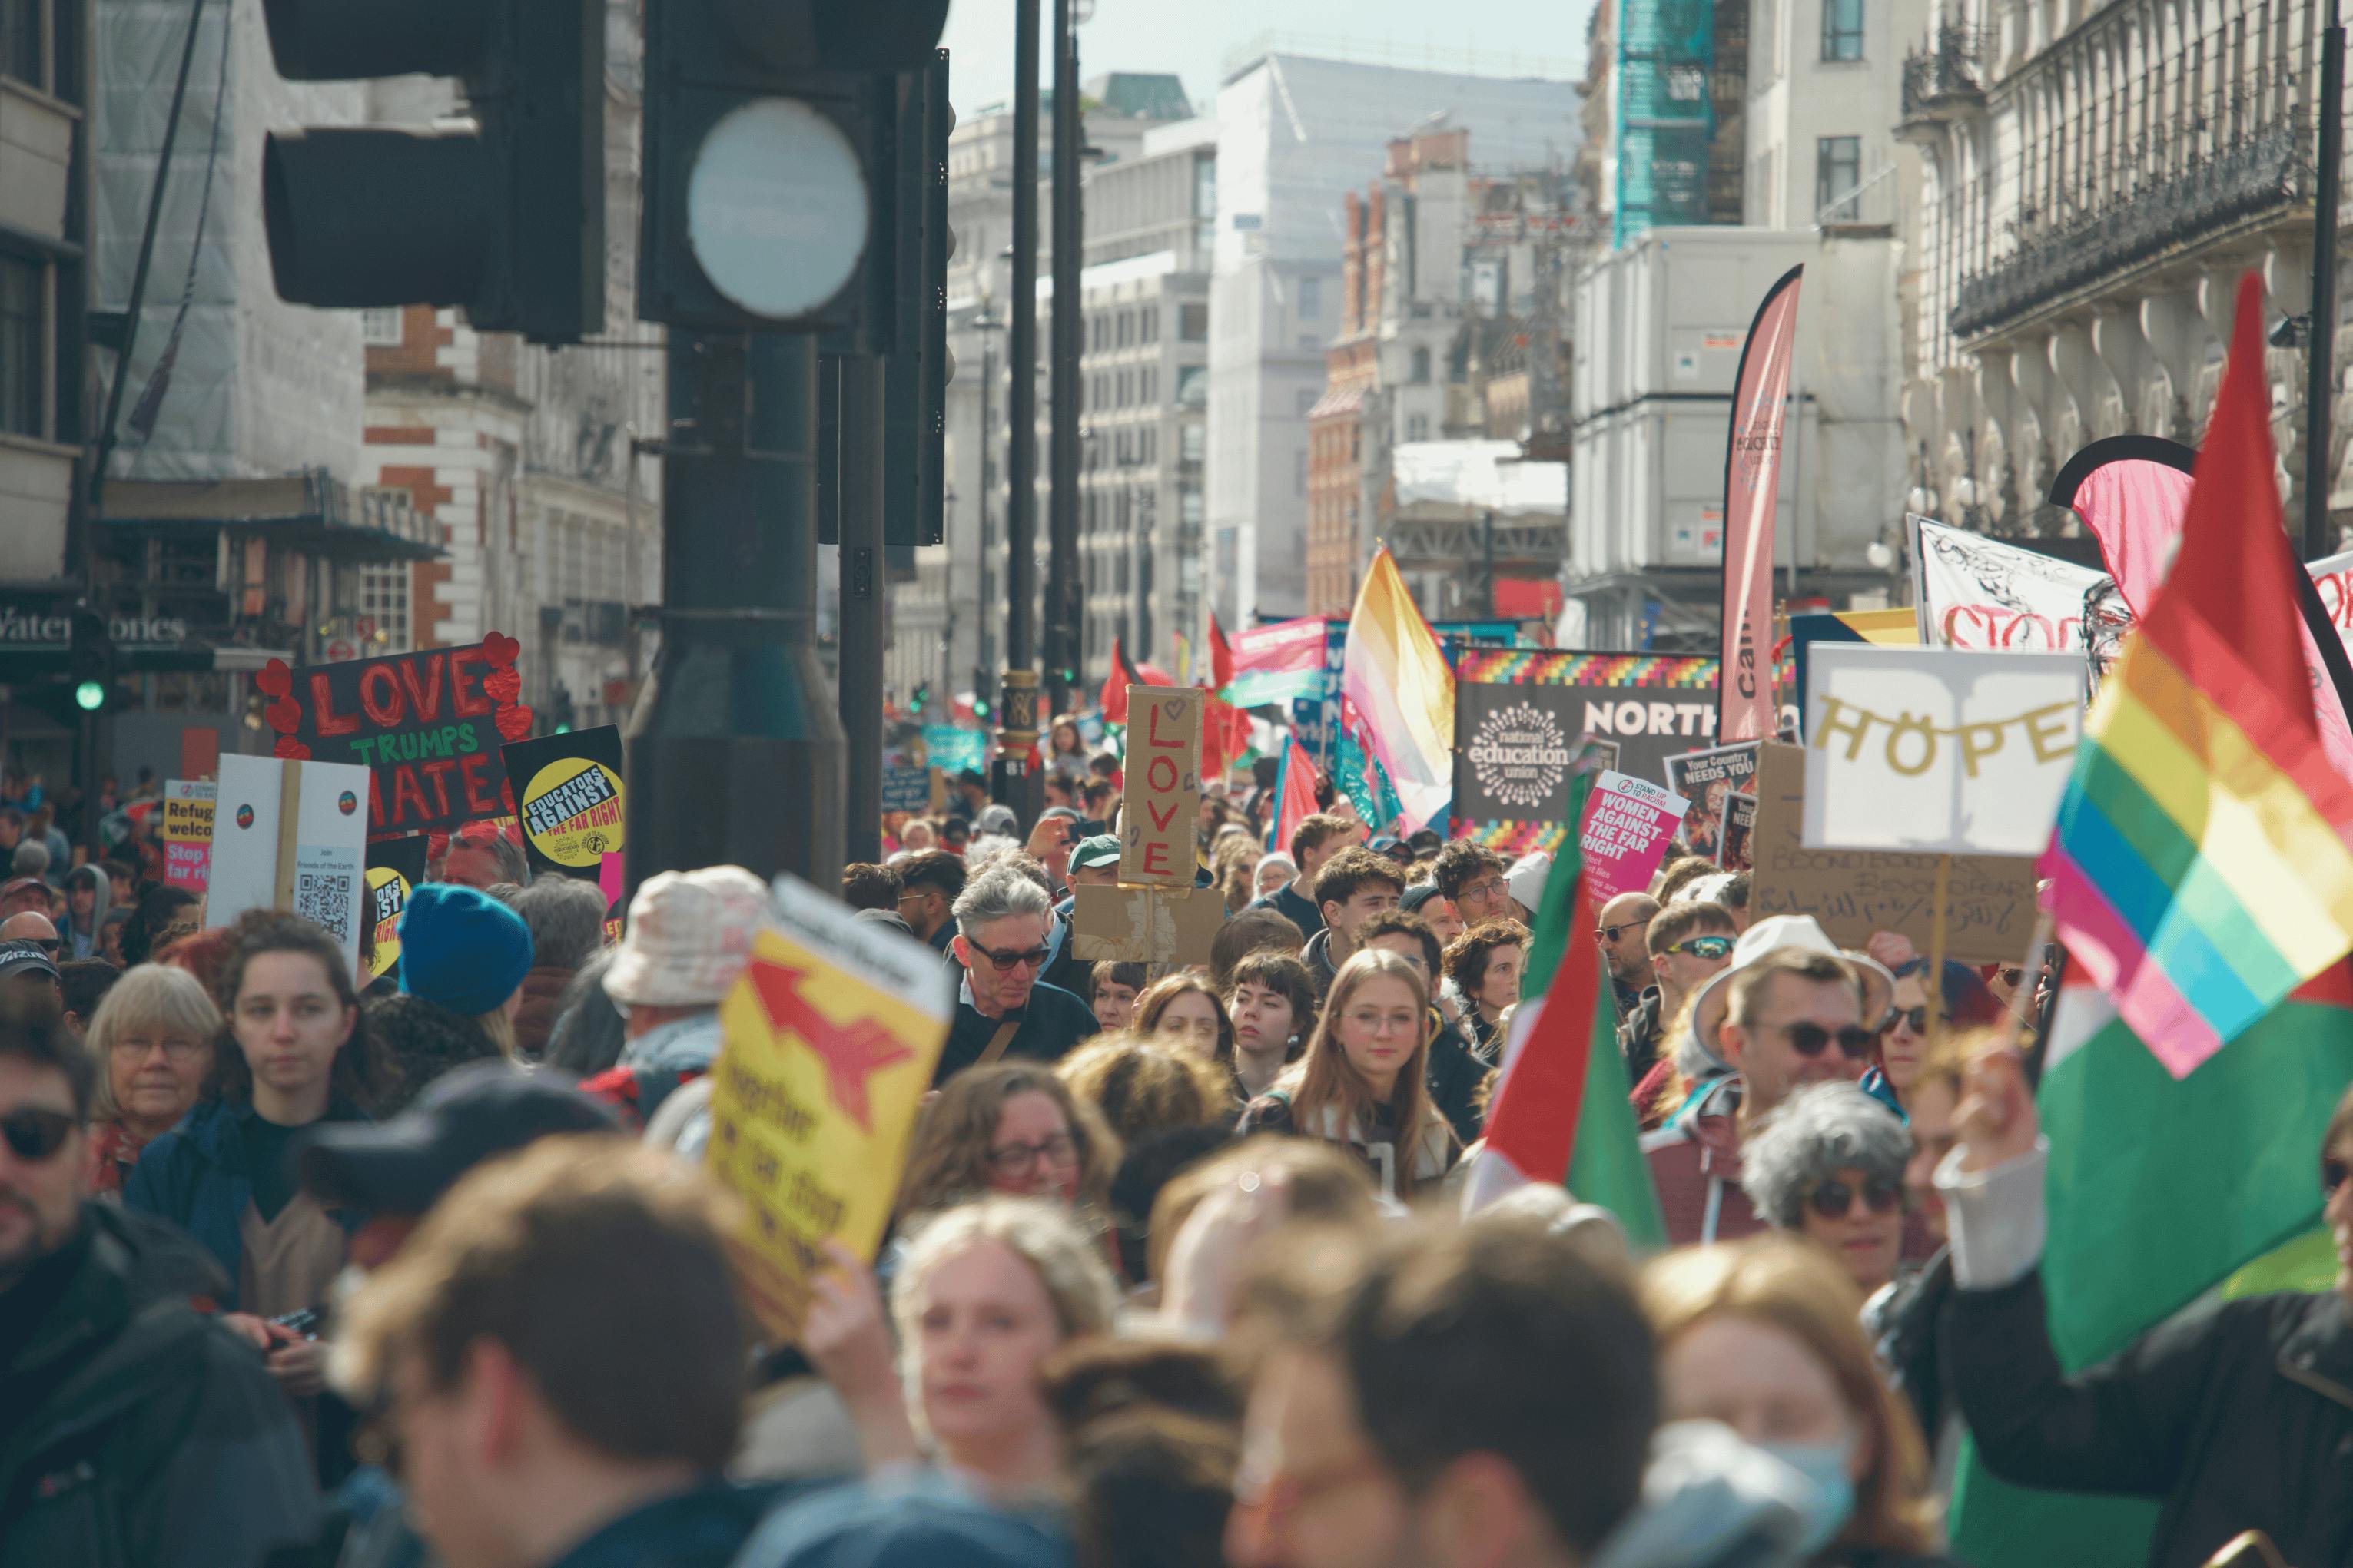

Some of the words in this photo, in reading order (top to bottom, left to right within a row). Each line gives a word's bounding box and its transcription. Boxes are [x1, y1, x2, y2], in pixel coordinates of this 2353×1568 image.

[310, 648, 492, 738] LOVE
[350, 724, 479, 765] TRUMPS
[1499, 731, 1545, 744] national
[1468, 742, 1569, 765] education
[1687, 760, 1708, 771] Your
[1709, 753, 1748, 767] Country
[1504, 766, 1538, 779] union
[1684, 767, 1725, 784] NEEDS
[1727, 761, 1754, 776] YOU
[528, 767, 603, 816] EDUCATORS
[1143, 704, 1186, 876] LOVE
[1632, 789, 1641, 797] TO
[1641, 794, 1666, 807] RACISM
[1635, 783, 1656, 796] STAND
[1657, 791, 1667, 800] UP
[168, 802, 213, 823] Refug
[529, 778, 610, 837] AGAINST
[546, 824, 567, 837] THE
[569, 812, 589, 832] FAR
[589, 796, 622, 828] RIGHT
[1601, 793, 1660, 824] WOMEN
[168, 821, 211, 837] welco
[1592, 807, 1663, 840] AGAINST
[1580, 834, 1628, 860] RIGHT
[1588, 820, 1618, 841] THE
[1618, 831, 1649, 854] FAR
[168, 844, 204, 864] Stop
